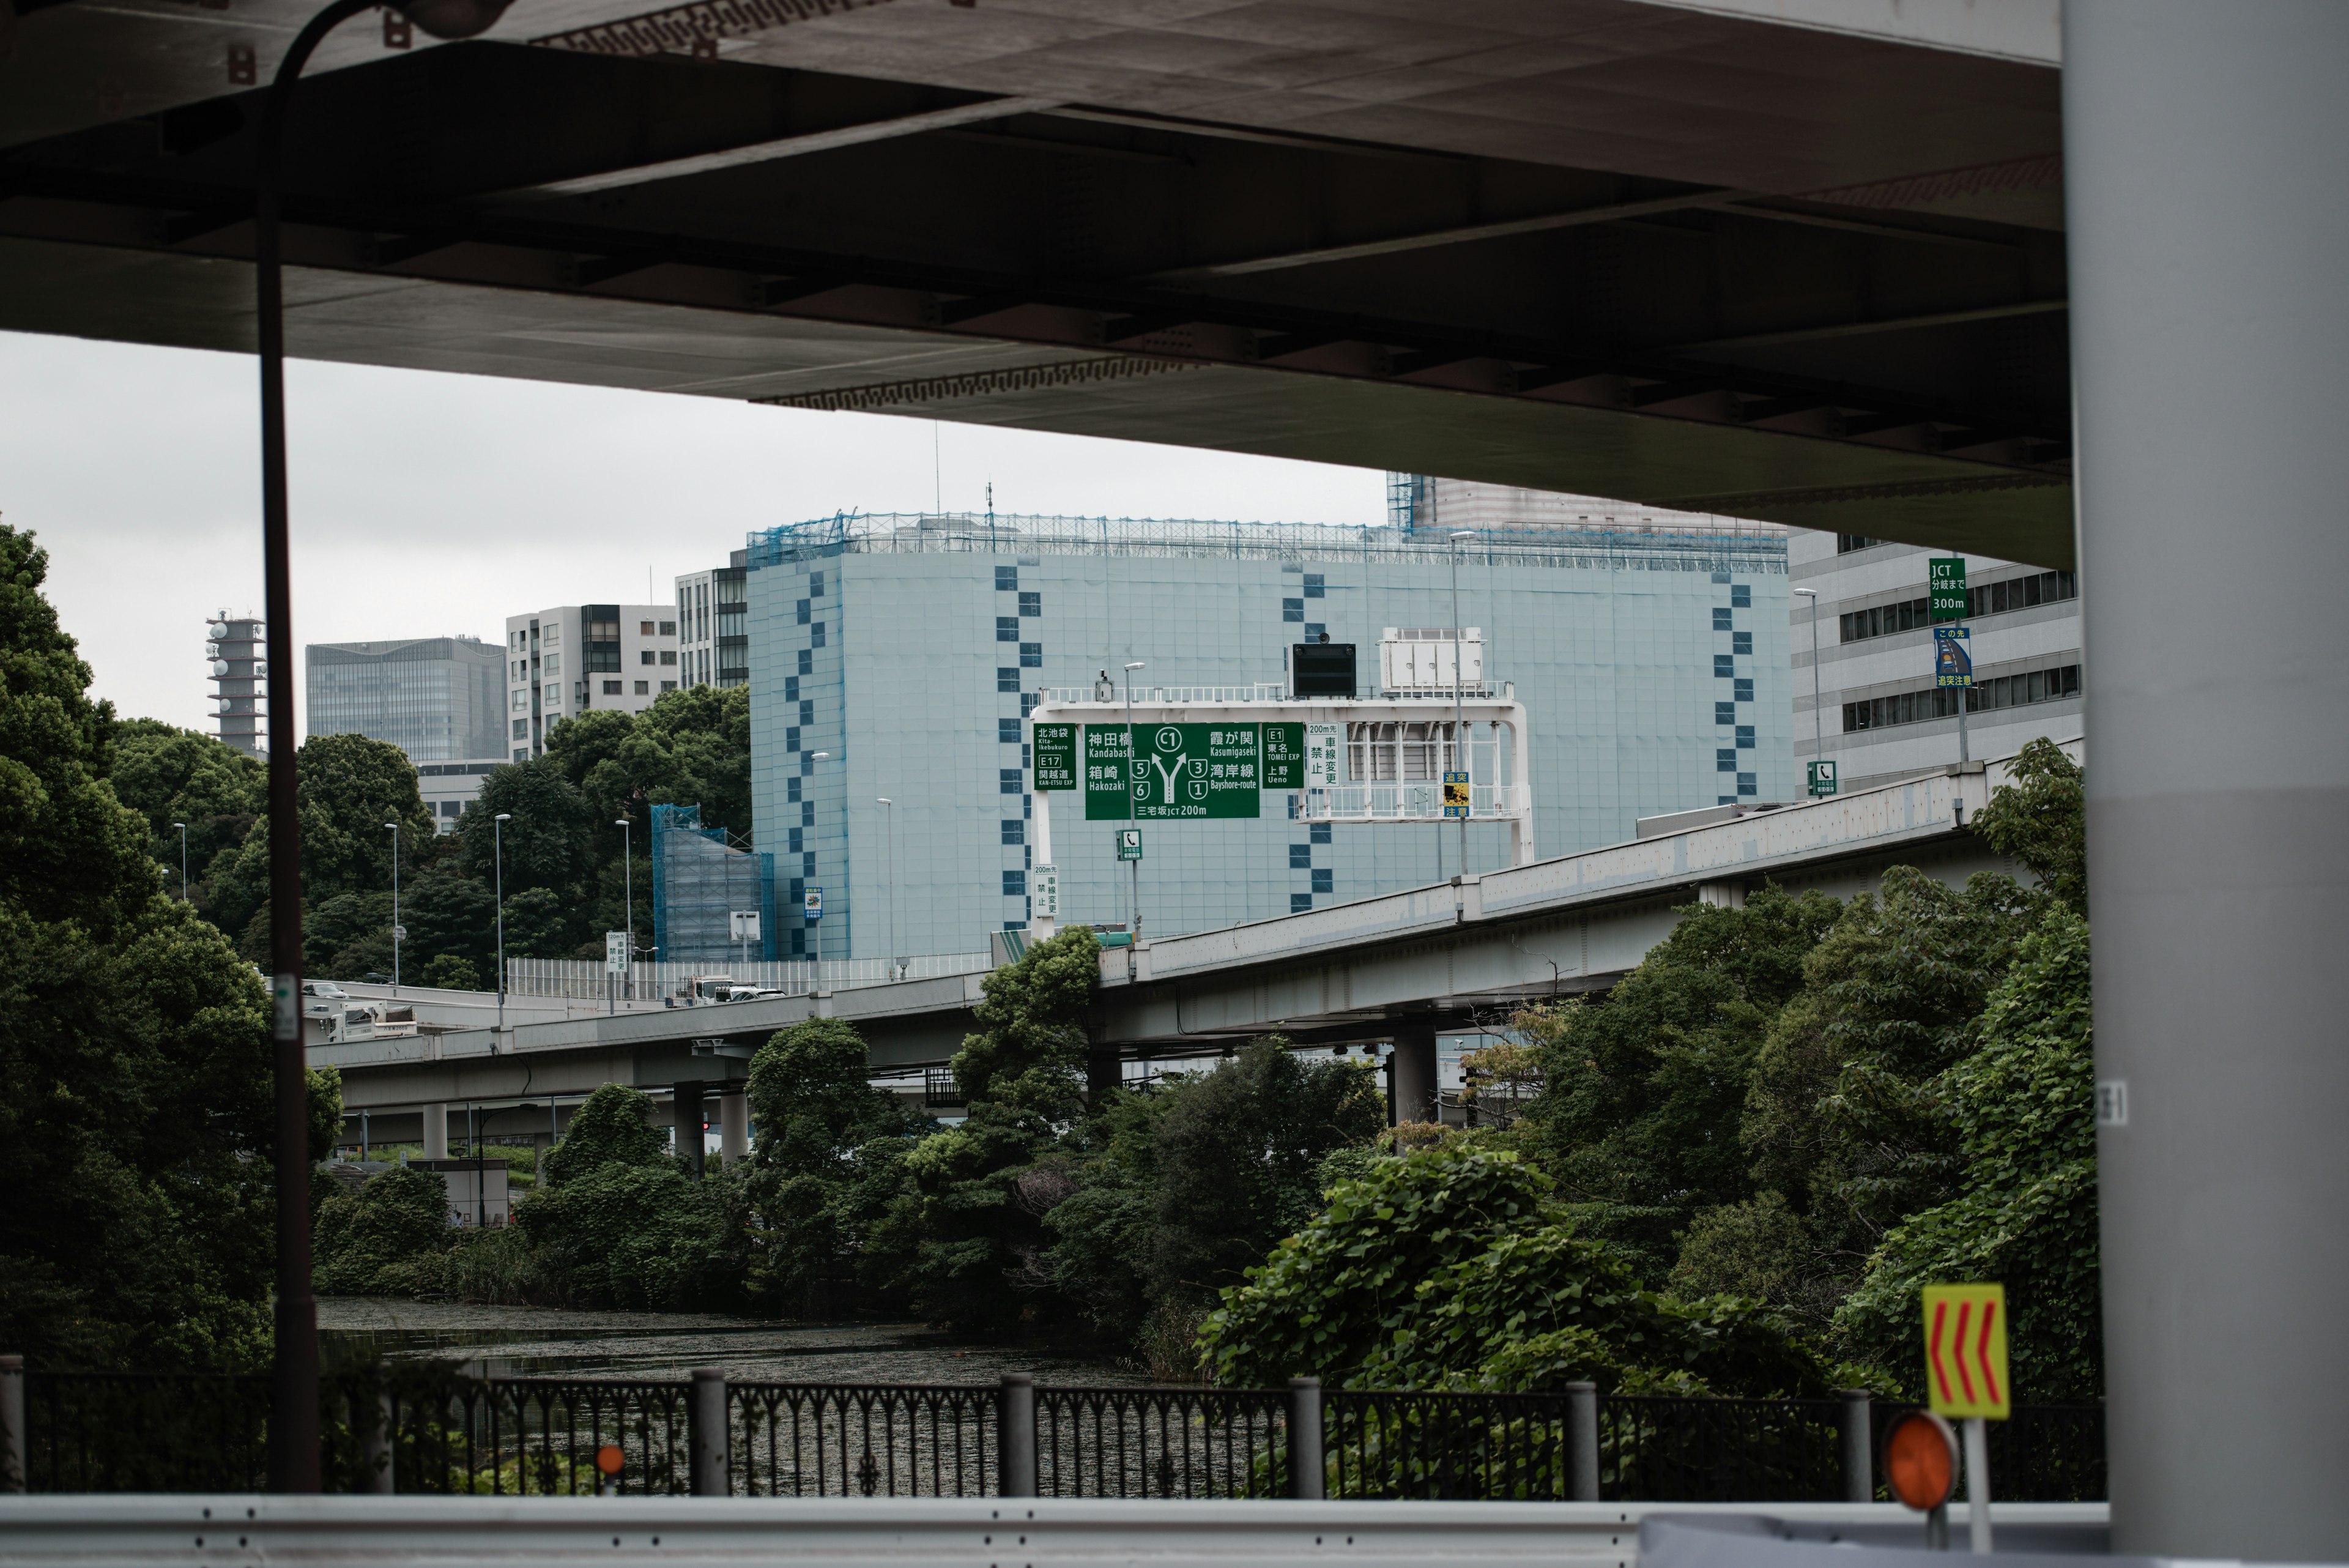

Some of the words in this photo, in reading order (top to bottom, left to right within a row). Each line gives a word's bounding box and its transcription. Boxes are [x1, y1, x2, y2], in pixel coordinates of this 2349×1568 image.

[1932, 565, 1951, 579] JCT
[1932, 579, 1965, 590] 分岐まで
[1934, 598, 1964, 609] 300m
[1939, 630, 1965, 638] この先
[1938, 675, 1972, 686] 追突注意
[1038, 728, 1068, 738] 北池袋
[1270, 731, 1282, 740] E1
[1310, 725, 1337, 734] 200m先
[1088, 732, 1132, 747] 神田橋
[1160, 732, 1175, 747] C1
[1210, 731, 1253, 745] 霞が関
[1210, 746, 1256, 759] Kasumigaseki
[1267, 743, 1288, 753] 東名
[1041, 757, 1059, 766] E17
[1311, 746, 1323, 774] 禁止
[1325, 737, 1337, 784] 車線変更
[1089, 765, 1118, 779] 箱崎
[1137, 763, 1144, 775] 5
[1195, 762, 1202, 774] 3
[1210, 764, 1254, 778] 湾岸線
[1267, 766, 1288, 776] 上野
[1039, 770, 1069, 779] 関越道
[1445, 773, 1466, 782] 追突
[1089, 780, 1125, 791] Hakozaki
[1137, 784, 1145, 796] 6
[1194, 784, 1202, 795] 1
[1211, 779, 1256, 792] Bayshore-route
[1446, 807, 1468, 816] 注意
[1037, 884, 1046, 906] 禁止
[1048, 877, 1056, 913] 車線変更
[609, 948, 617, 964] 禁止
